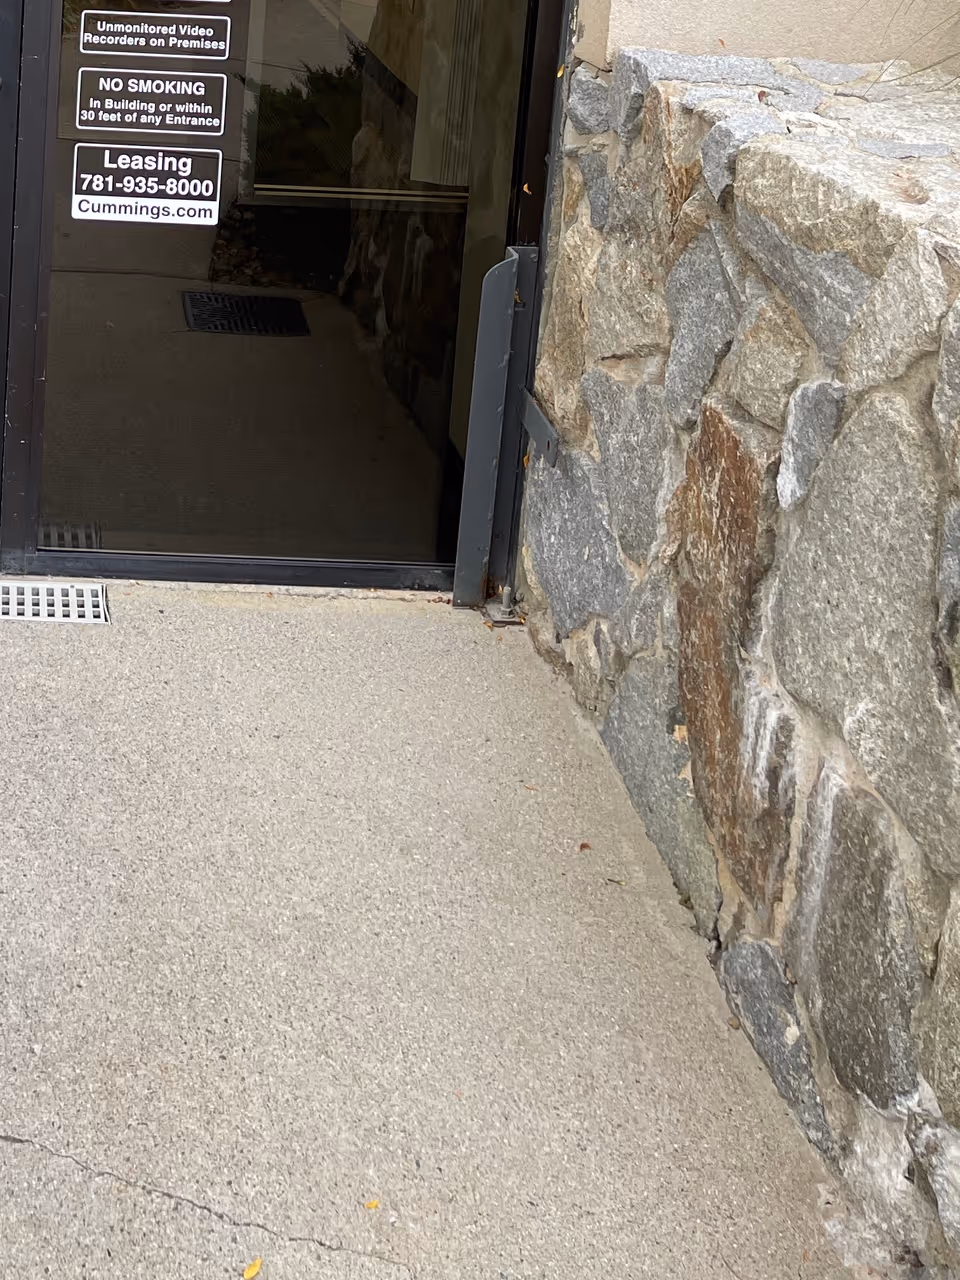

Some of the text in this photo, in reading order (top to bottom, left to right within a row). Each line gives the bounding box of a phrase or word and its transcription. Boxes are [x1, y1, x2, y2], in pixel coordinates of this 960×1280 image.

[97, 21, 214, 37] Unmonitored Video
[83, 32, 226, 50] Recorders on Premises
[99, 77, 205, 95] NO SMOKING
[89, 98, 212, 114] In Building or within
[80, 110, 220, 126] 30 feet of any Entrance
[104, 149, 192, 176] Leasing
[80, 173, 213, 197] 781-935-8000
[78, 199, 213, 219] Cummings.com
